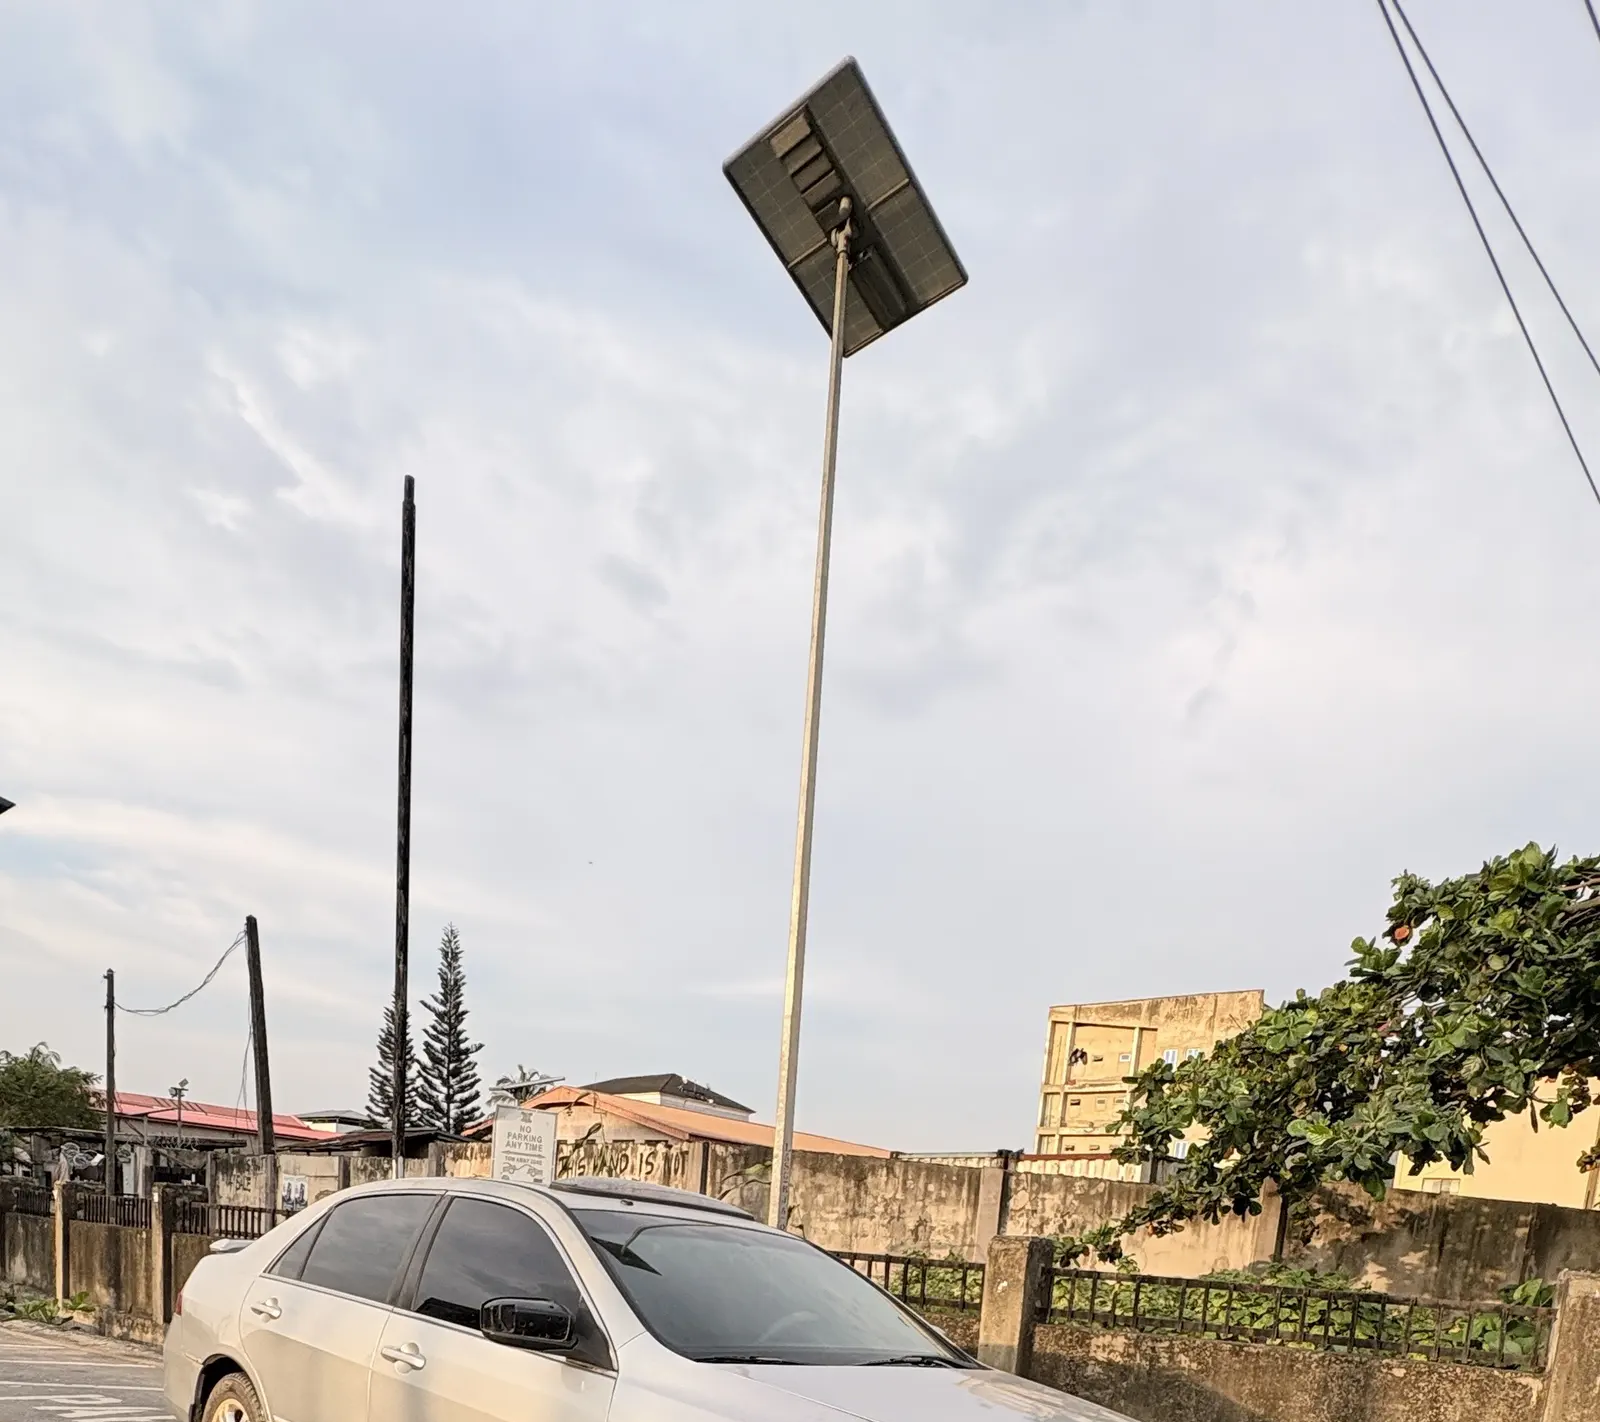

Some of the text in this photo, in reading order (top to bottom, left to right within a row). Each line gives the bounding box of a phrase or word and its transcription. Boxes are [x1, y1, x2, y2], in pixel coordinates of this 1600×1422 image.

[519, 1124, 532, 1133] NO
[507, 1132, 543, 1143] PARKING
[505, 1140, 544, 1152] ANY TIME
[639, 1151, 655, 1176] IS
[664, 1149, 690, 1178] NOT
